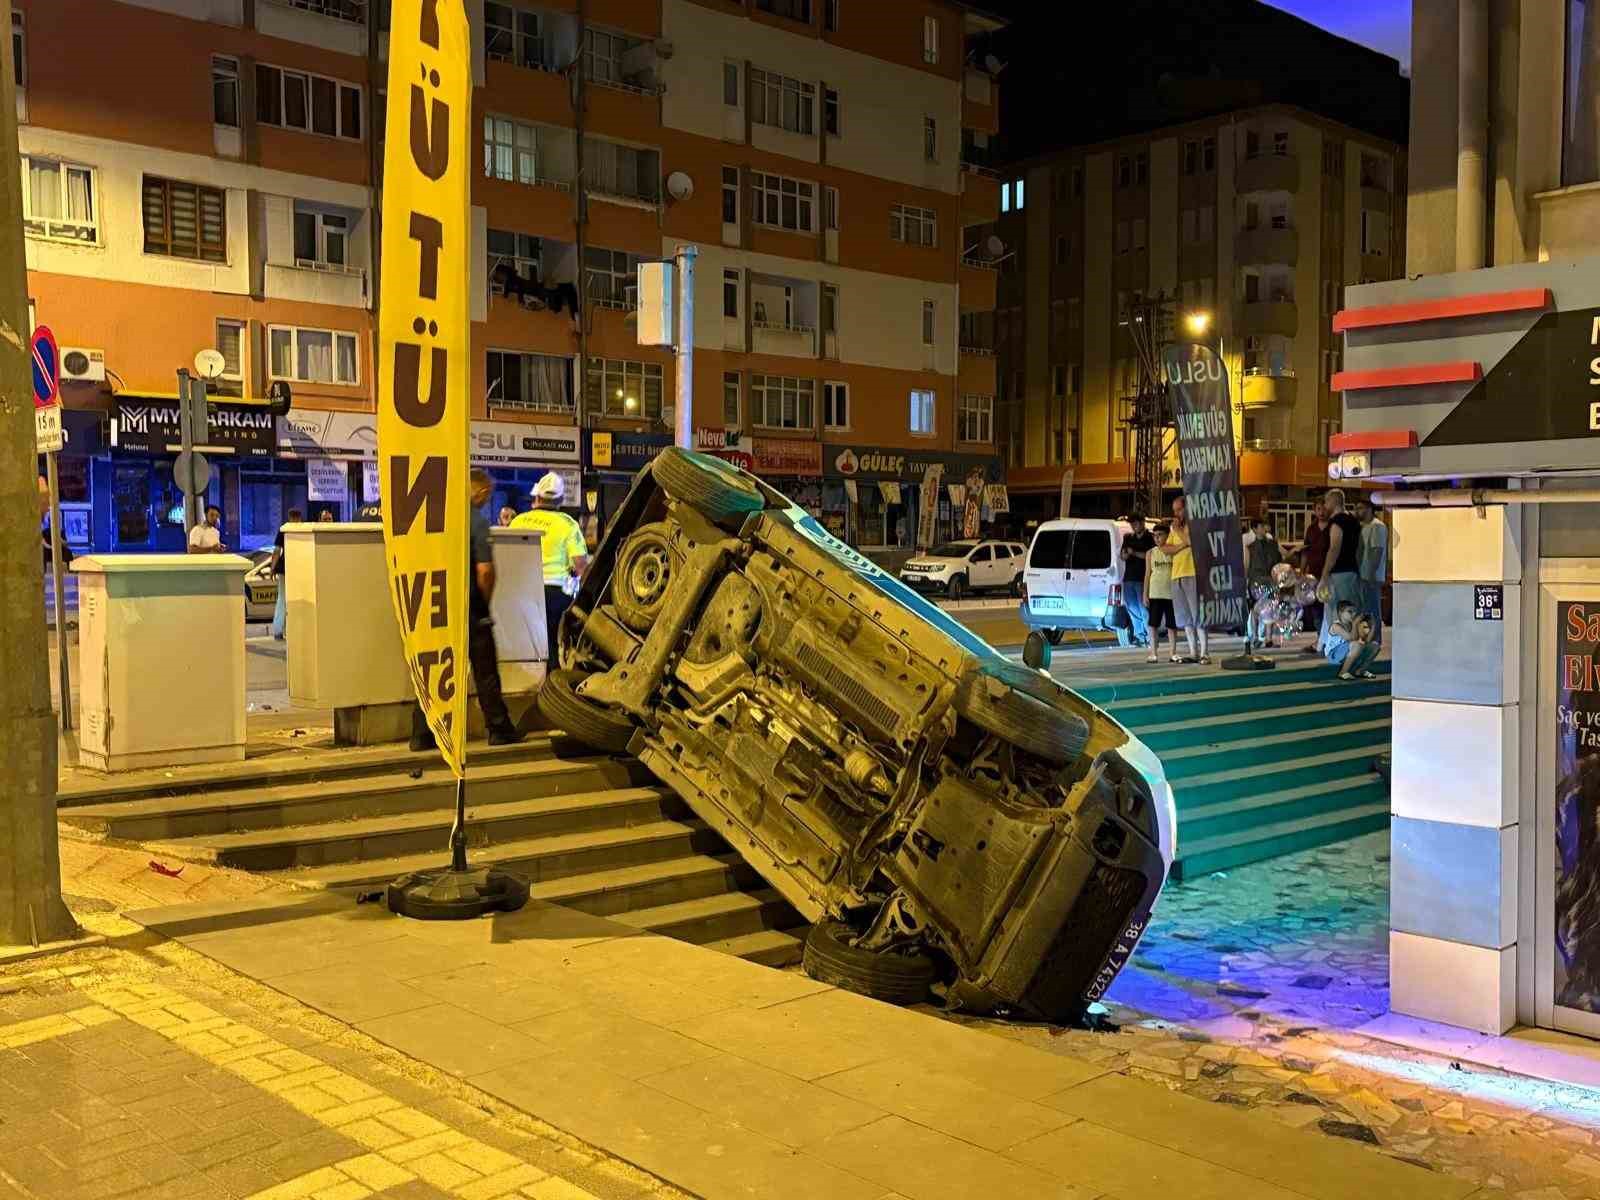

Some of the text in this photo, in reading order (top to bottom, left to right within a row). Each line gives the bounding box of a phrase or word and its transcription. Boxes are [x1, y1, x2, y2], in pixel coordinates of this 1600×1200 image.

[1557, 704, 1582, 730] Saç
[1087, 920, 1143, 999] 38 A 74323
